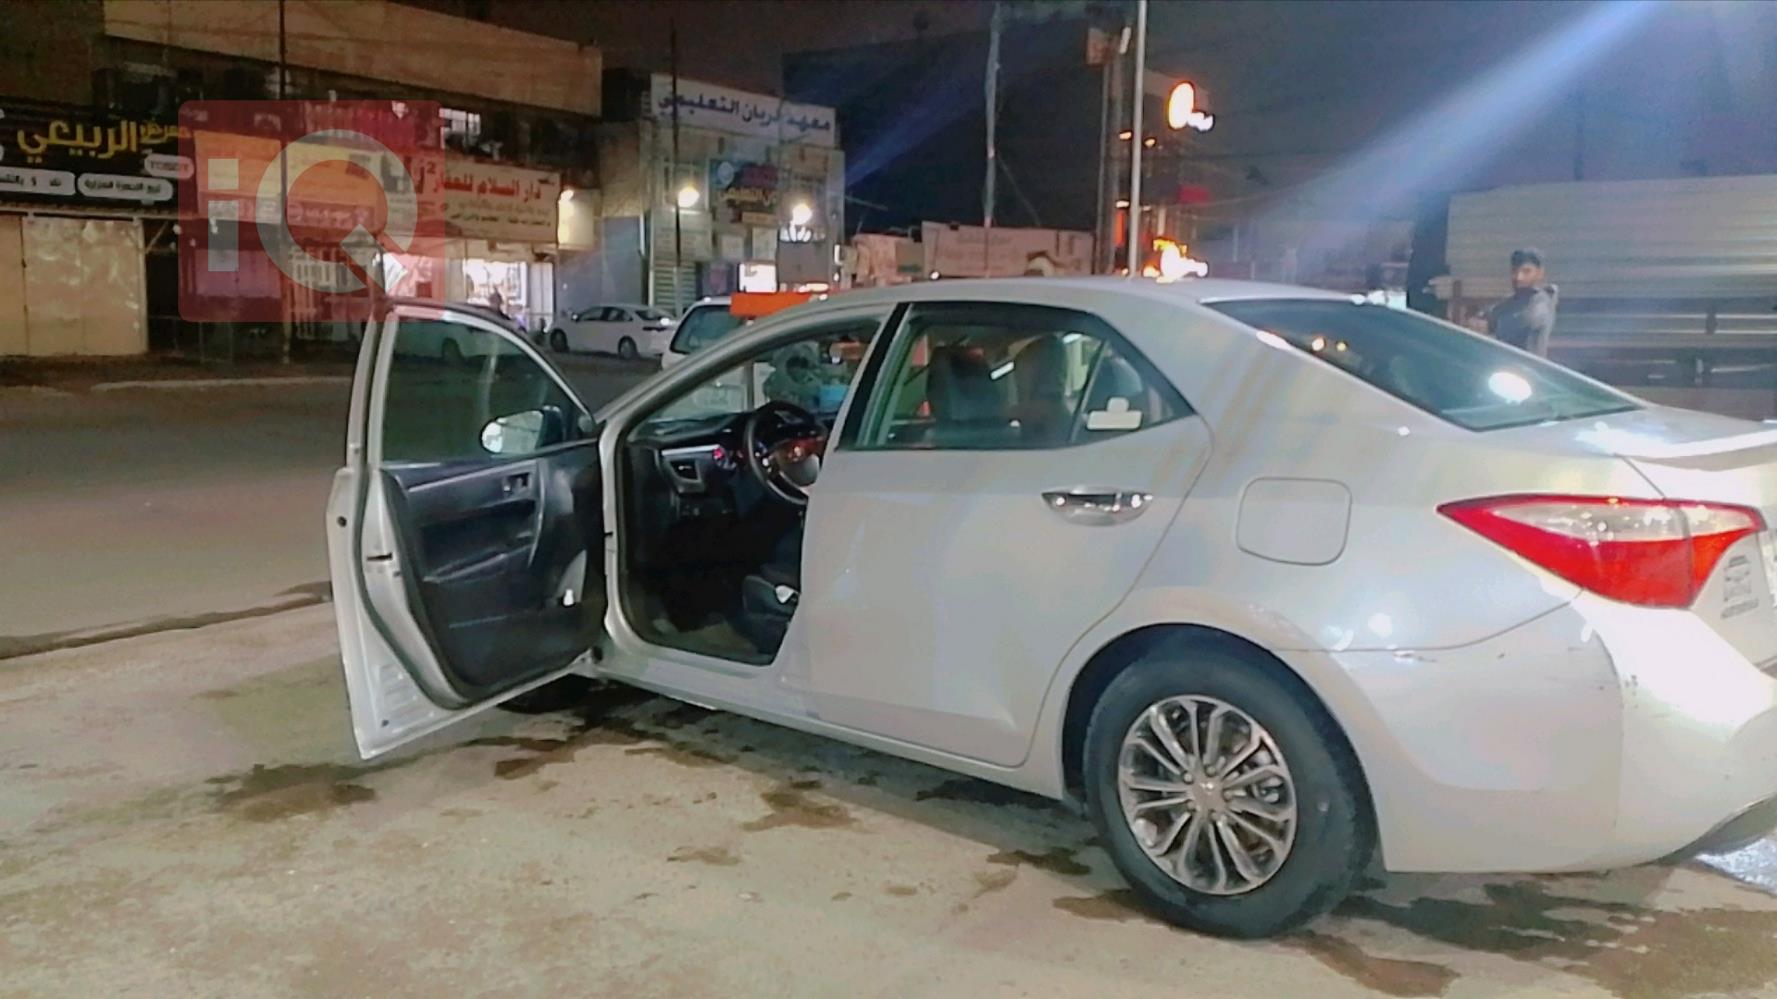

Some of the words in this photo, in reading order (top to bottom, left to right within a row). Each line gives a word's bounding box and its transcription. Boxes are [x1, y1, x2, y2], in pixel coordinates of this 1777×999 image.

[658, 93, 740, 117] التعليمي
[786, 114, 831, 132] معهد
[17, 119, 138, 164] الربيعي
[477, 176, 520, 200] السلام
